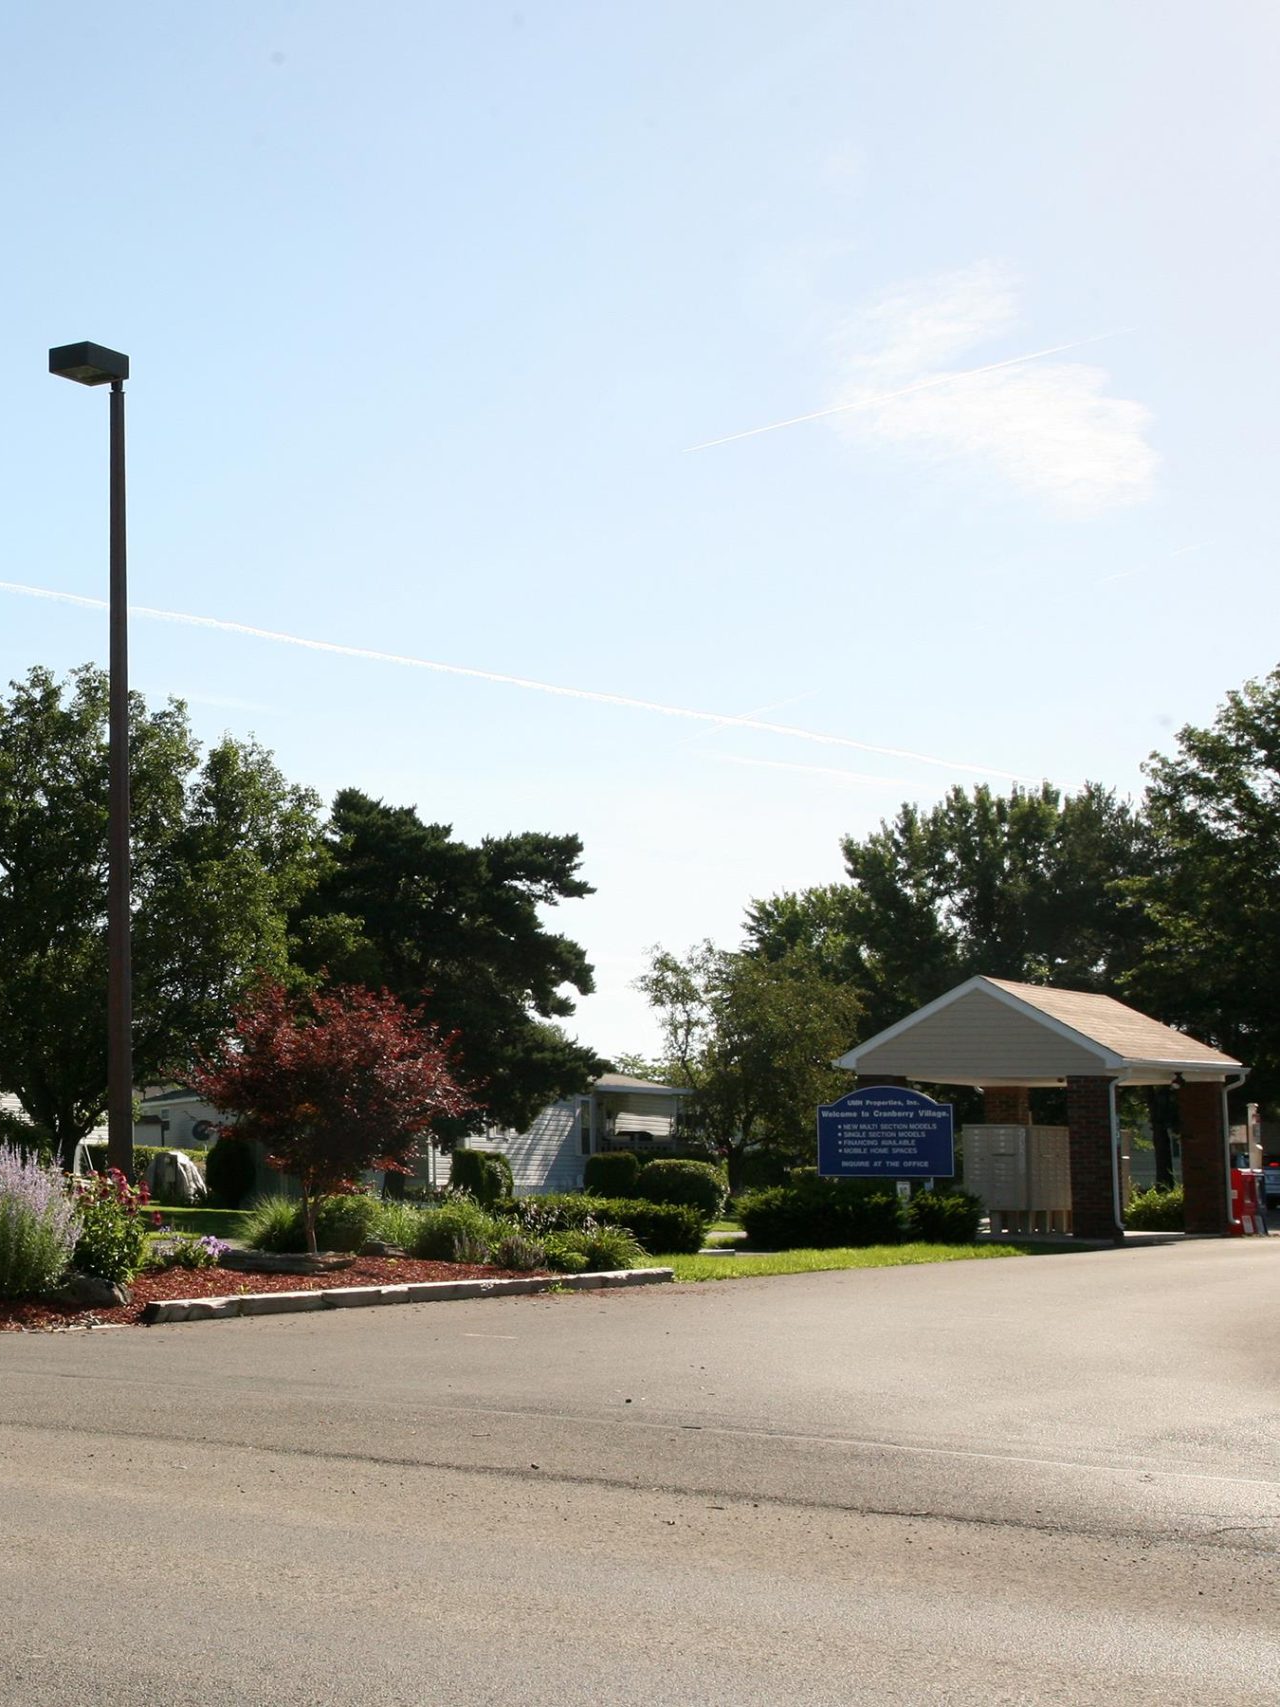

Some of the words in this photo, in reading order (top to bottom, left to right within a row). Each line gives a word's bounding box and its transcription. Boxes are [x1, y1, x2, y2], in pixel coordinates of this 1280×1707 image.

[821, 1110, 857, 1118] Welcome
[861, 1110, 870, 1118] to
[873, 1110, 914, 1119] Cranberry
